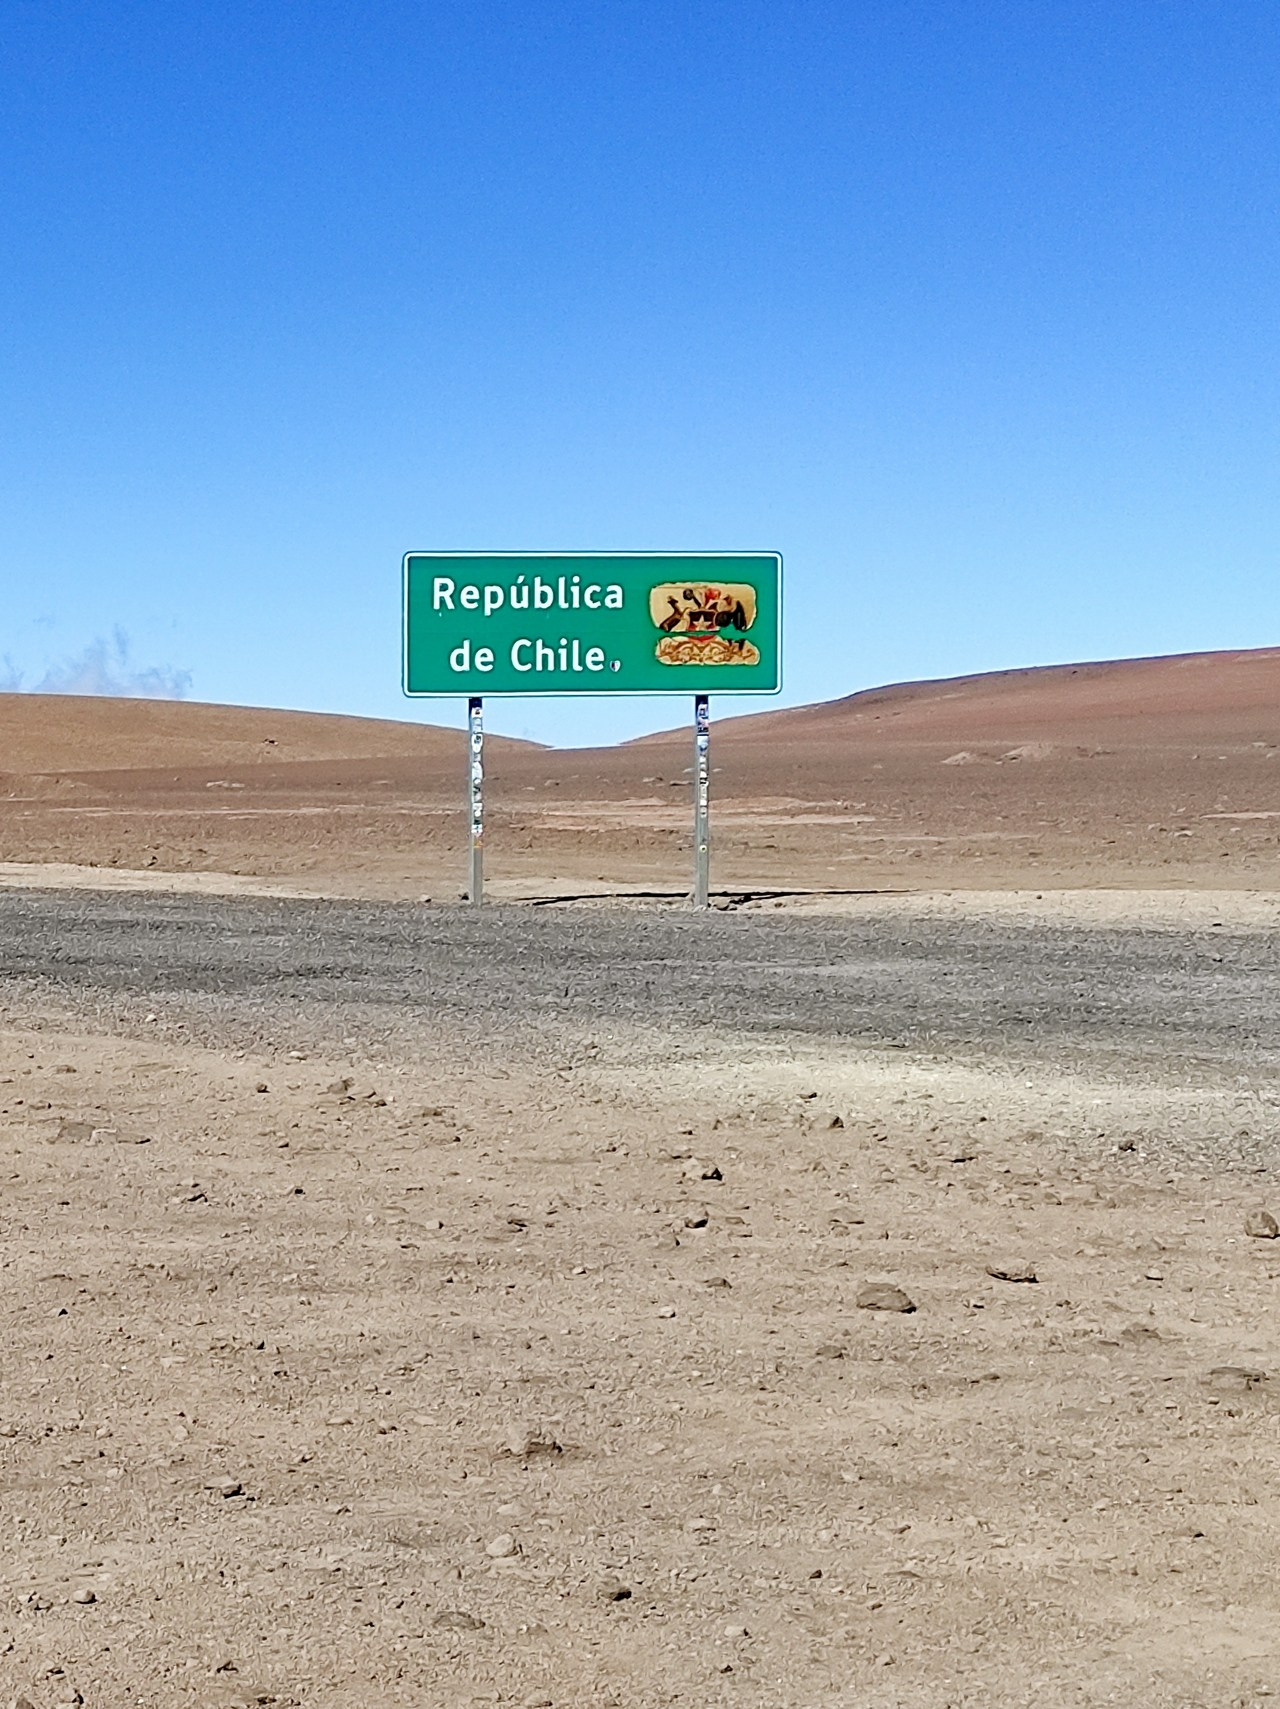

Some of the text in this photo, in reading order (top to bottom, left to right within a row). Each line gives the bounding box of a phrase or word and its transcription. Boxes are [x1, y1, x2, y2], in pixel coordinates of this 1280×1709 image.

[432, 575, 623, 616] República
[449, 638, 606, 672] de Chile
